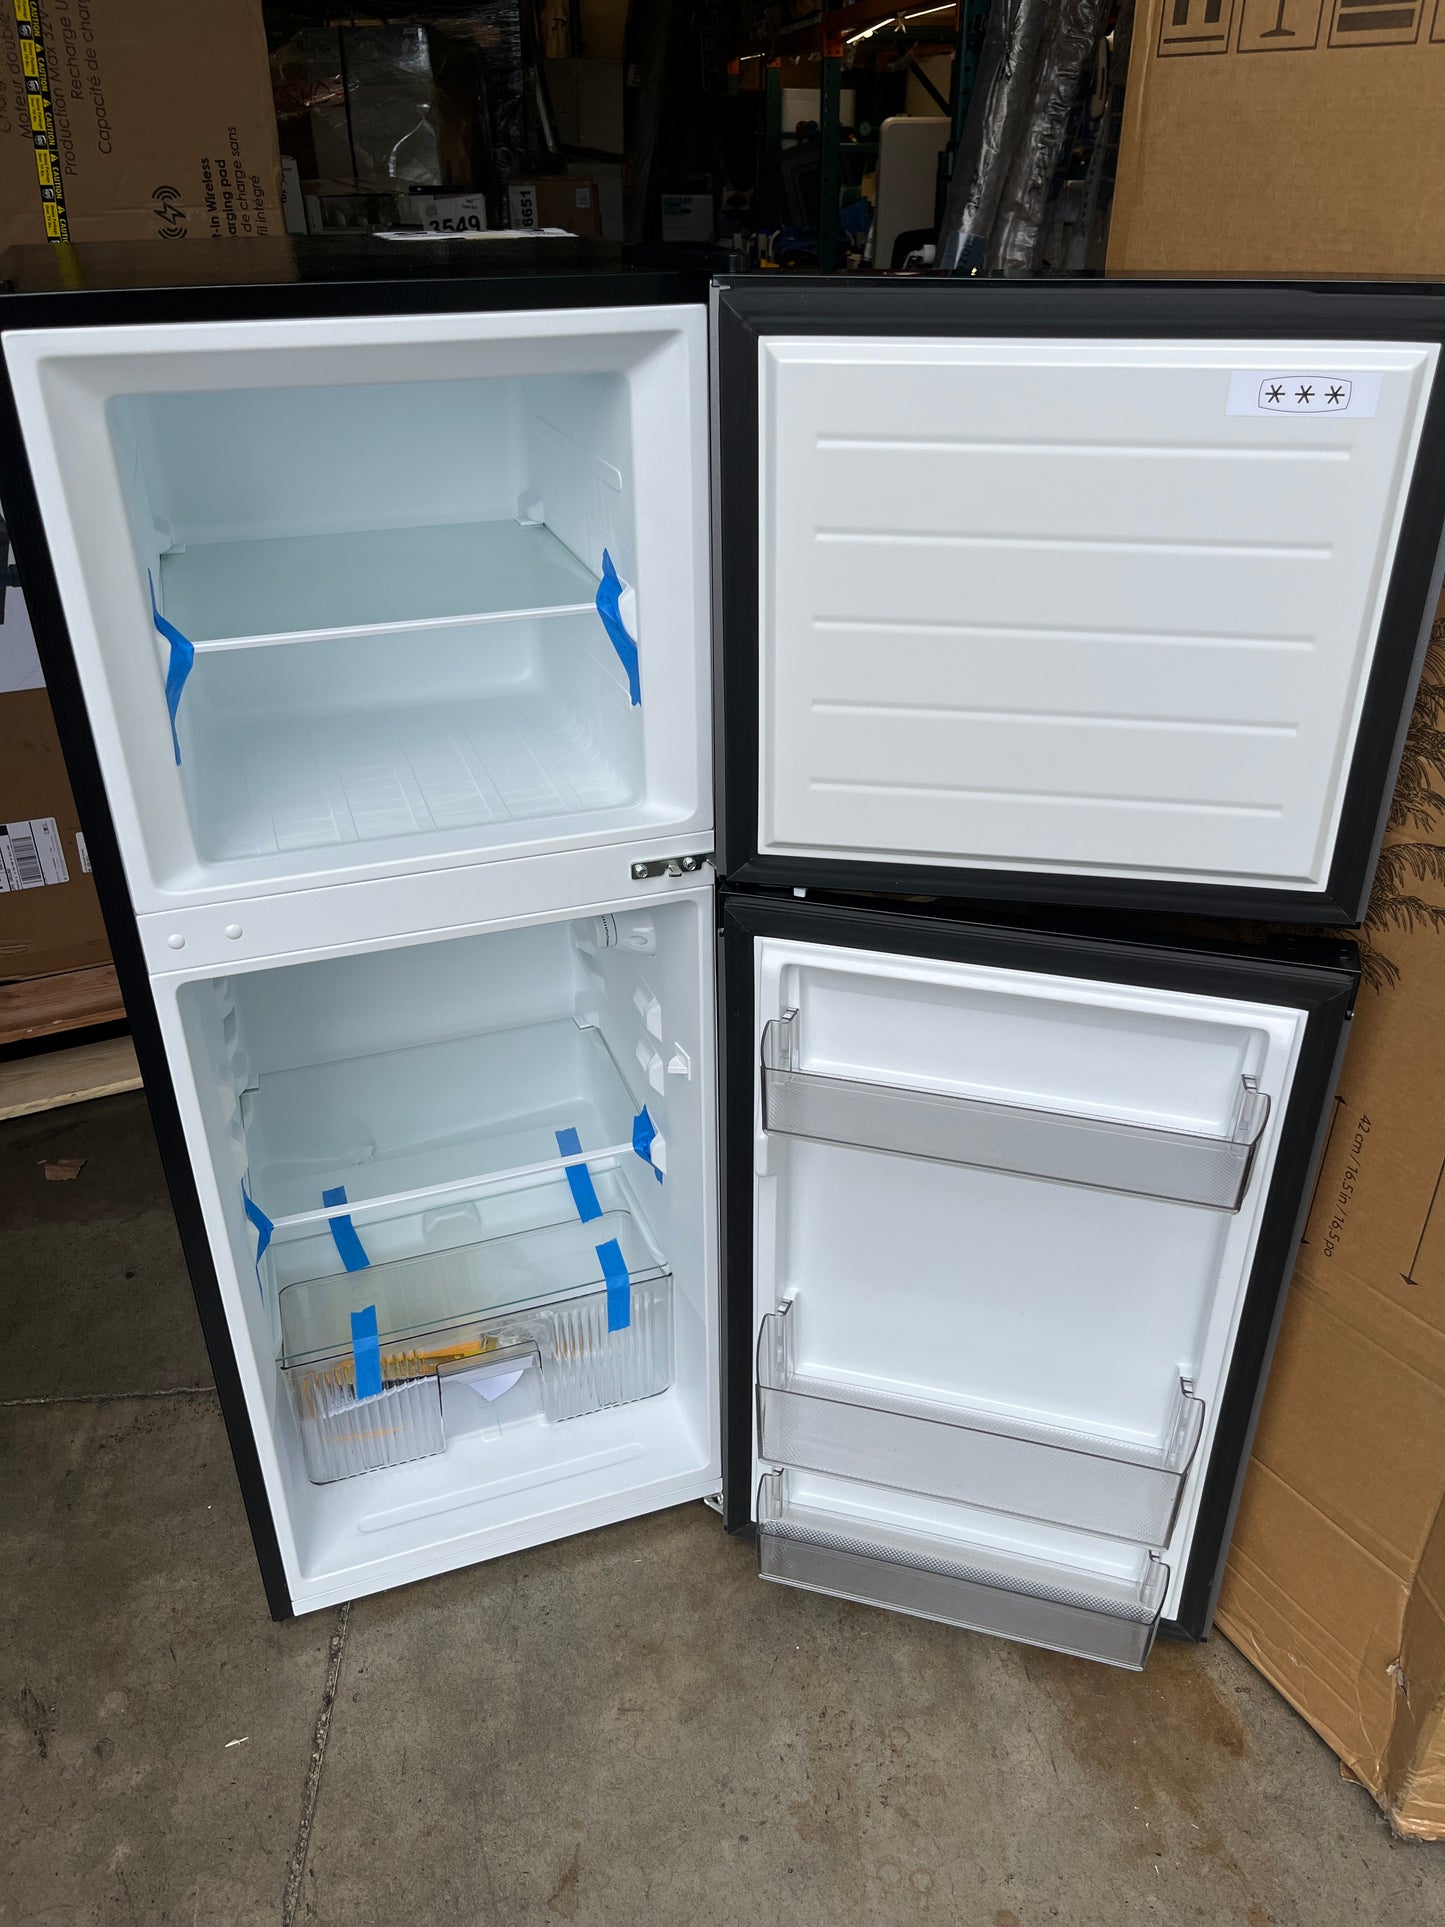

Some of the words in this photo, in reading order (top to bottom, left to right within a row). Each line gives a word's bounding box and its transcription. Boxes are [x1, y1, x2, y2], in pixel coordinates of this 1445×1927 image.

[46, 46, 62, 83] Max
[59, 17, 84, 100] Recharge
[83, 48, 99, 71] de
[11, 79, 32, 140] Moteur
[29, 1, 41, 37] CAUTION
[37, 57, 48, 92] CAUTION
[44, 112, 56, 146] CAUTION
[52, 167, 62, 199] CAUTION
[86, 76, 113, 155] Capacité
[53, 88, 78, 176] Production
[227, 126, 240, 157] sans
[201, 157, 217, 212] Wireless
[215, 159, 231, 187] pad
[233, 160, 249, 210] charge
[248, 175, 266, 223] intégré
[520, 190, 534, 227] 6651
[241, 214, 252, 233] de
[1357, 1115, 1372, 1133] 42
[1350, 1133, 1364, 1154] cm
[1342, 1165, 1358, 1192] 16.5
[1337, 1192, 1351, 1205] in
[1327, 1216, 1344, 1242] 16,5
[1323, 1239, 1335, 1257] po
